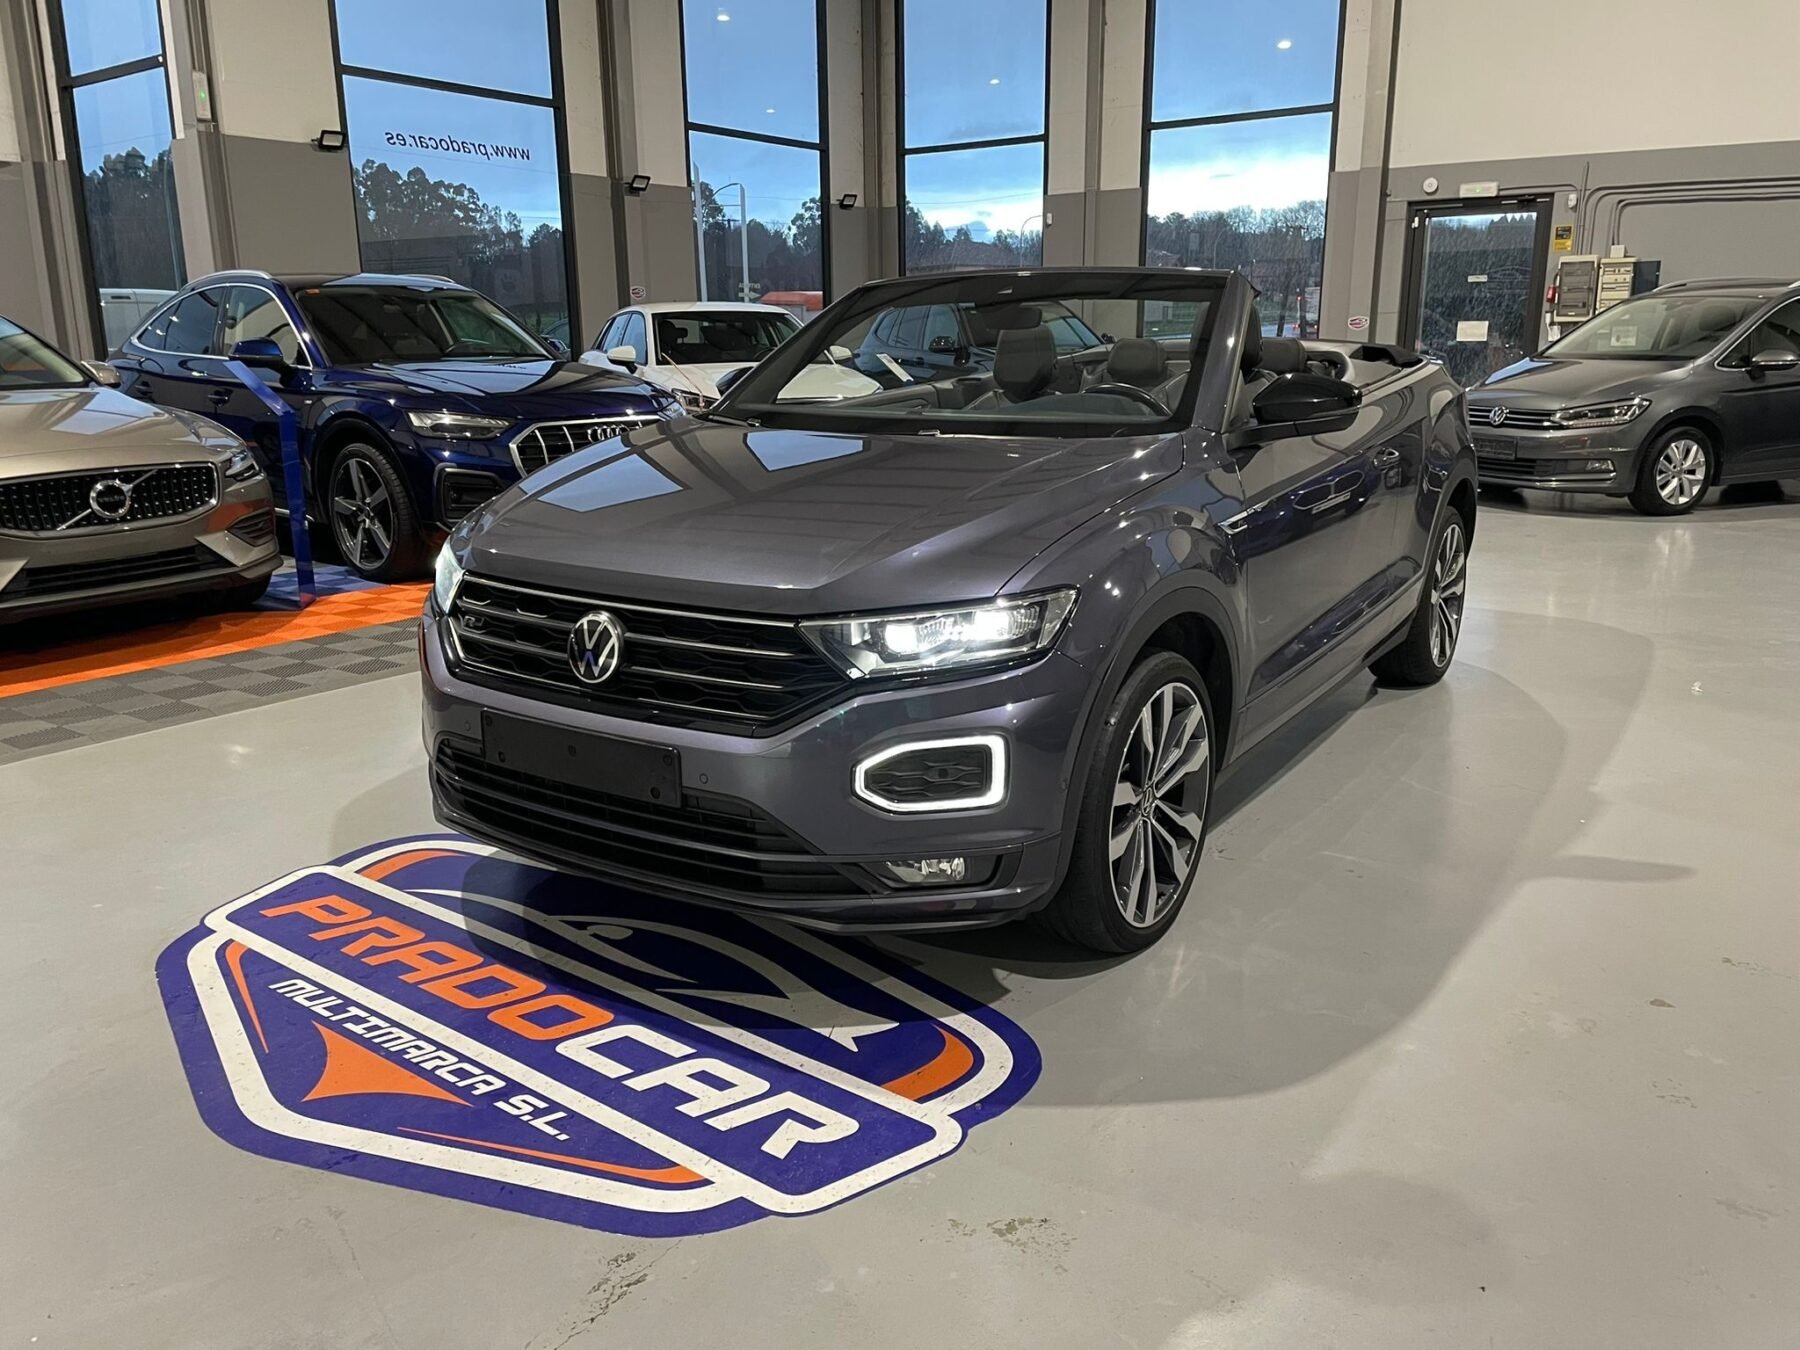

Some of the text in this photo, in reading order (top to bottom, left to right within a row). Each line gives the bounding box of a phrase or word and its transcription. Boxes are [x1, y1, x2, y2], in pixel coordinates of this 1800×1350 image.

[259, 895, 860, 1160] PRADOCAR
[268, 978, 570, 1141] MULTIMARCA S.L.
